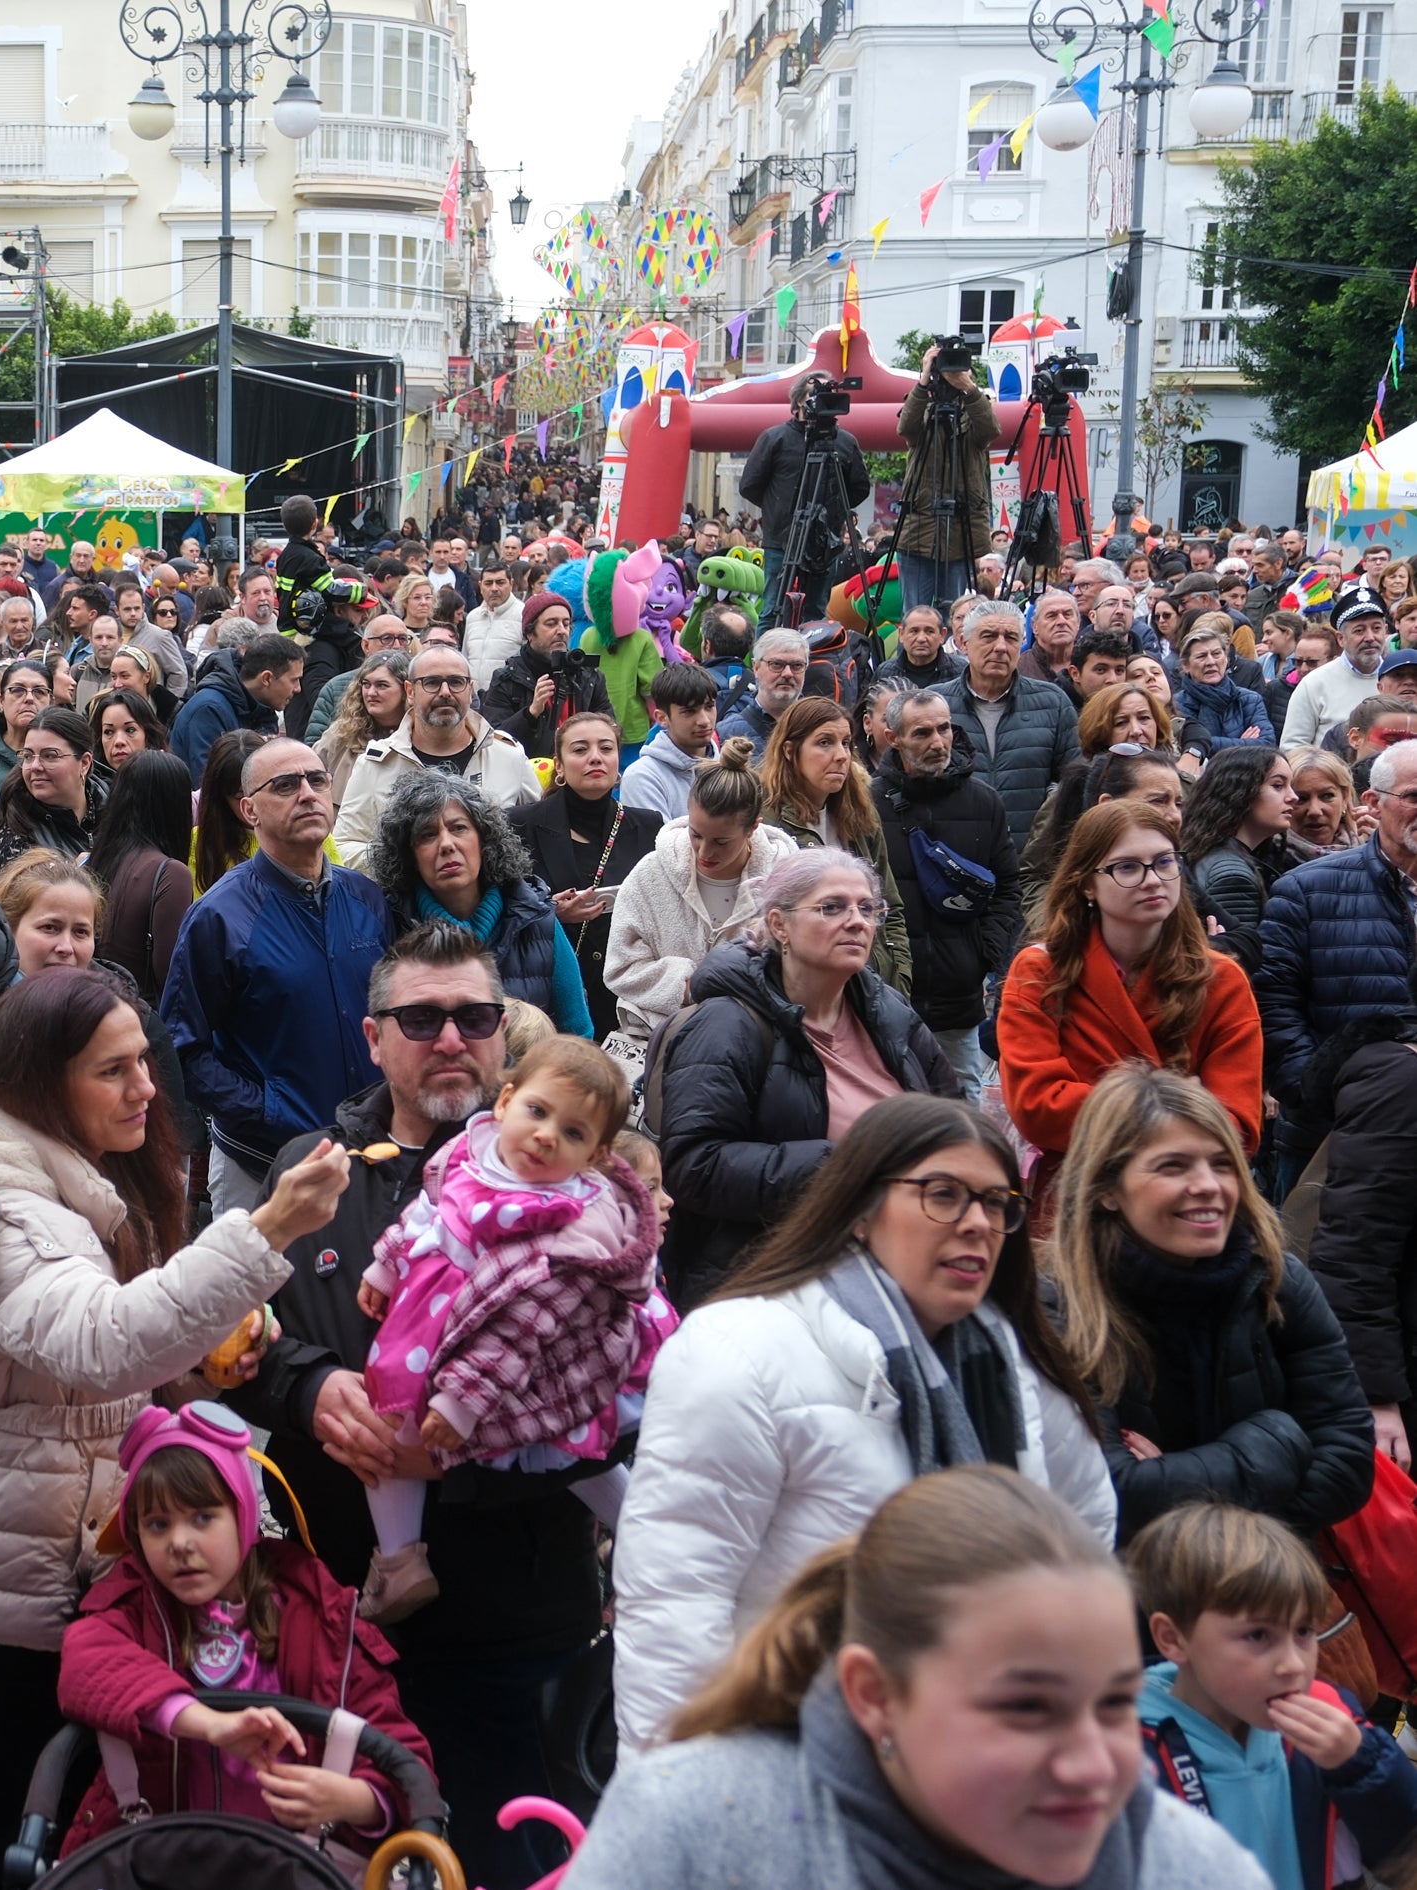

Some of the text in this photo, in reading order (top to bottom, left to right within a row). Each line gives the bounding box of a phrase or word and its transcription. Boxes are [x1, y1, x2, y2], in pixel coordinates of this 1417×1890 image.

[1080, 389, 1121, 398] ANTON
[121, 478, 170, 492] PESCA
[106, 494, 180, 506] DE PATITOS
